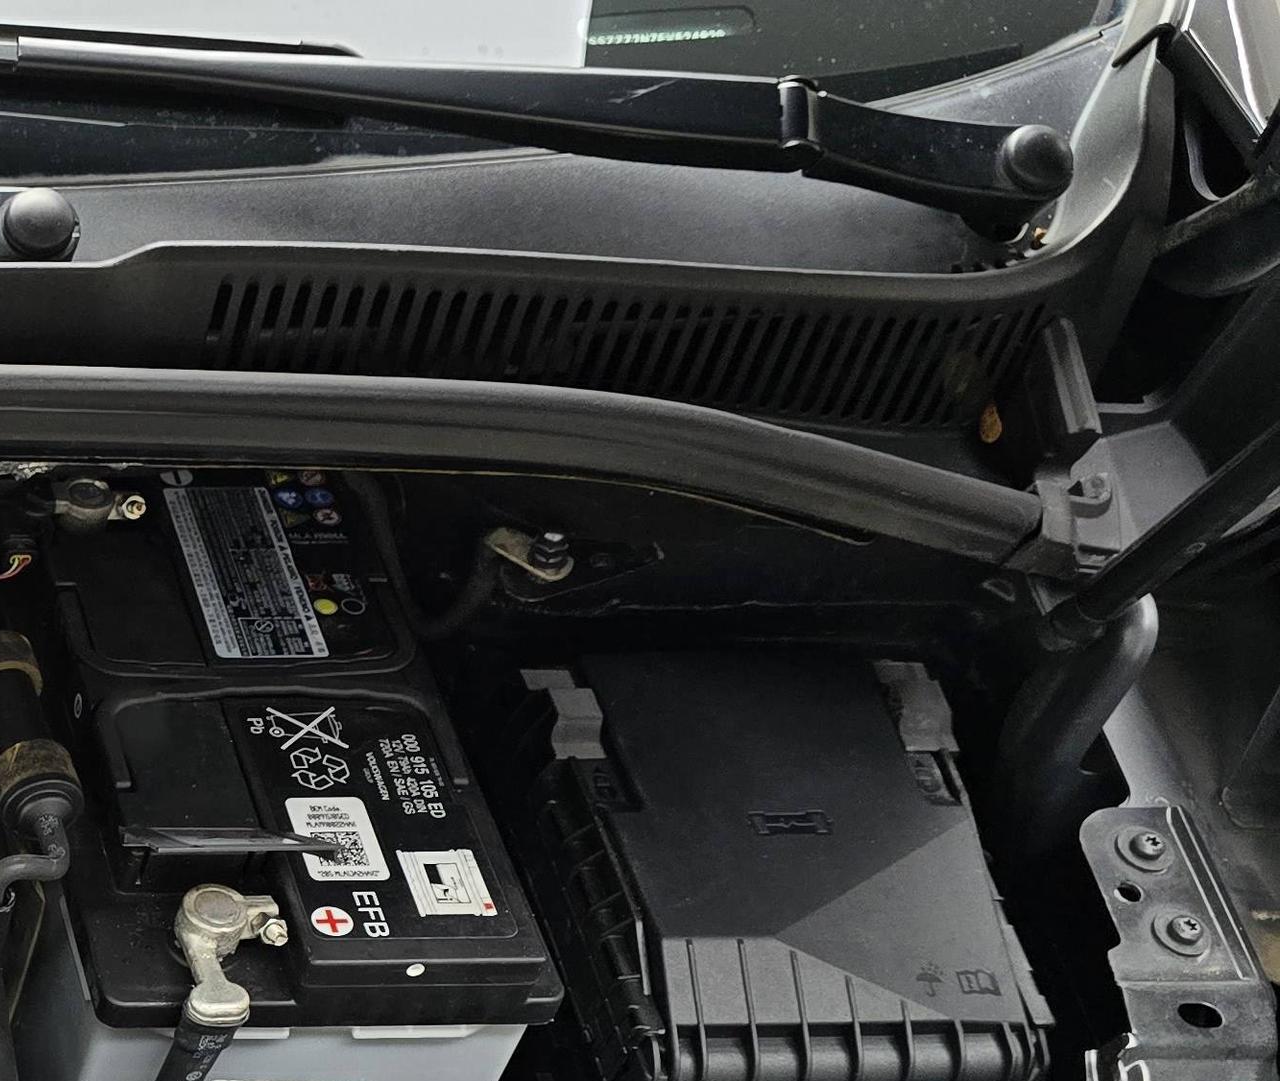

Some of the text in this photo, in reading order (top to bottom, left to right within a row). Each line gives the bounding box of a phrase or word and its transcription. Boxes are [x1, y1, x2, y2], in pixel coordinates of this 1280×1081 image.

[247, 718, 265, 734] Pb
[401, 734, 421, 753] 000
[410, 756, 430, 775] 915
[366, 752, 390, 800] VOLKSWAGEN
[386, 761, 400, 773] EN
[394, 778, 409, 796] SAE
[402, 801, 416, 815] GS
[419, 780, 439, 798] 105
[427, 802, 446, 818] ED
[352, 891, 390, 938] EFB
